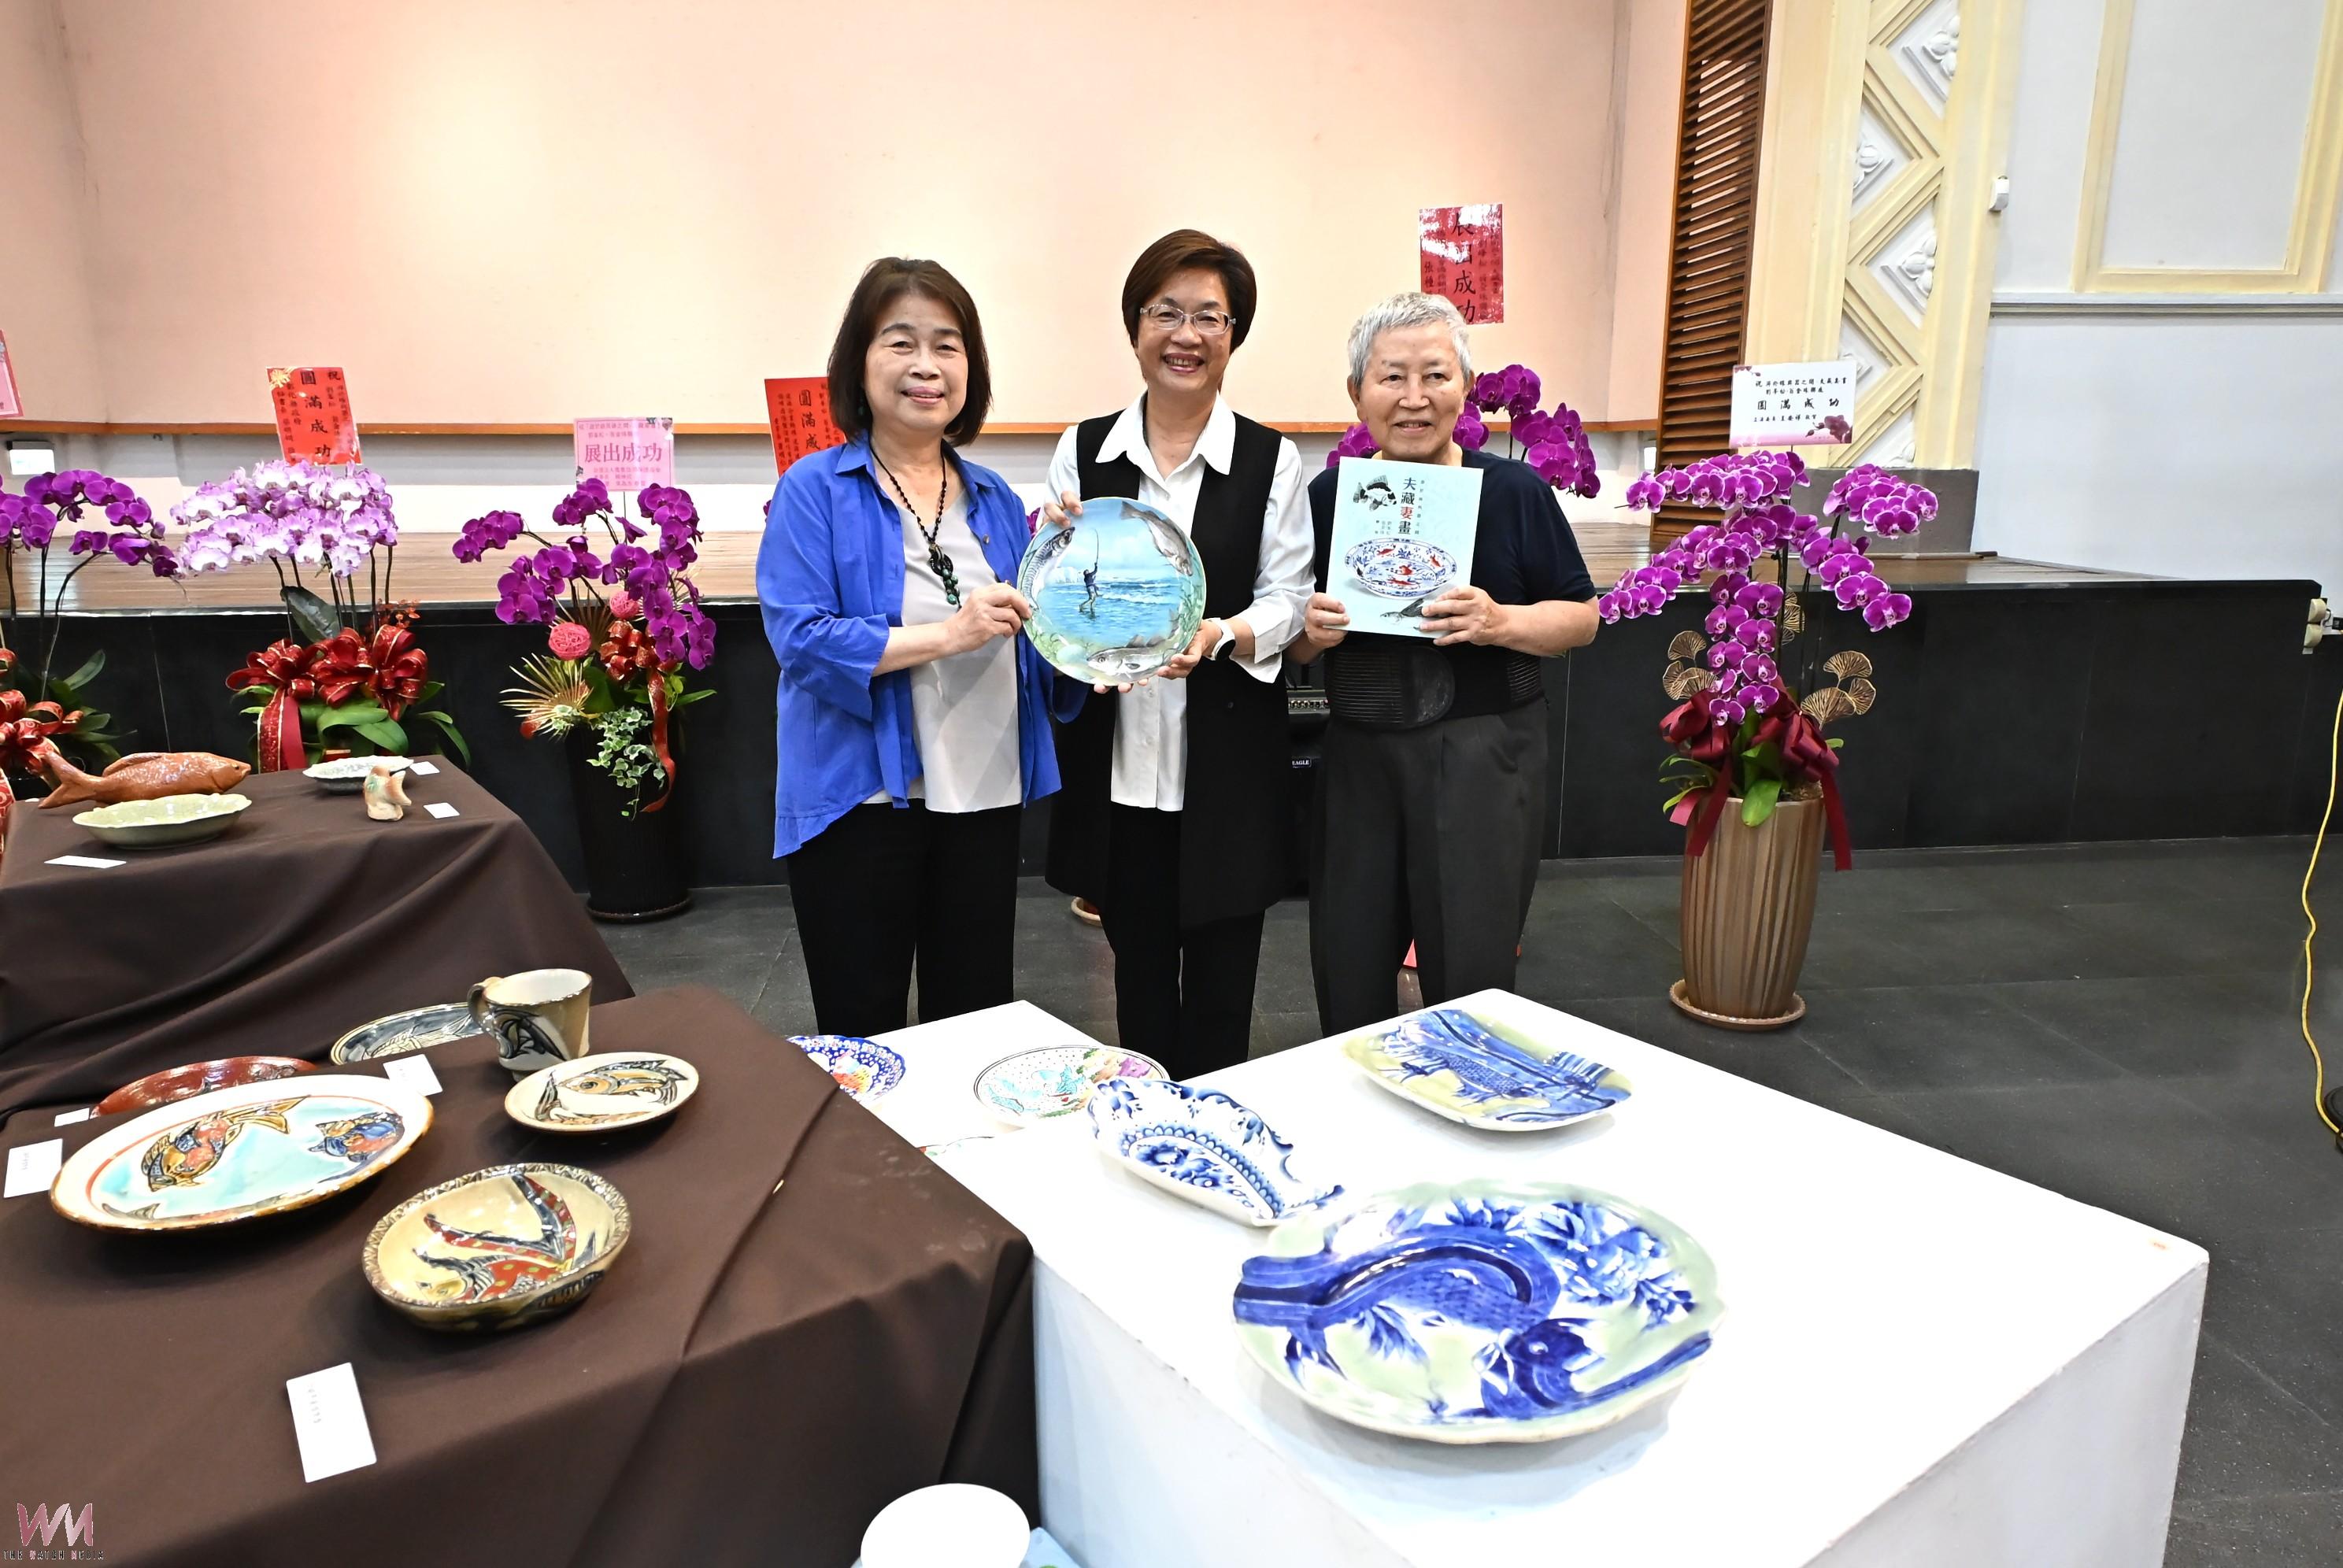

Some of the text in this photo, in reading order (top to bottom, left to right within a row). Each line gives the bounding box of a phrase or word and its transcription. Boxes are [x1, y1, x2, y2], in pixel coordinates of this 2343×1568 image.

[300, 370, 331, 457] 圓滿成功
[1757, 398, 1840, 410] 圓滿成功
[584, 442, 662, 463] 展出成功
[1397, 476, 1417, 535] 夫藏妻畫
